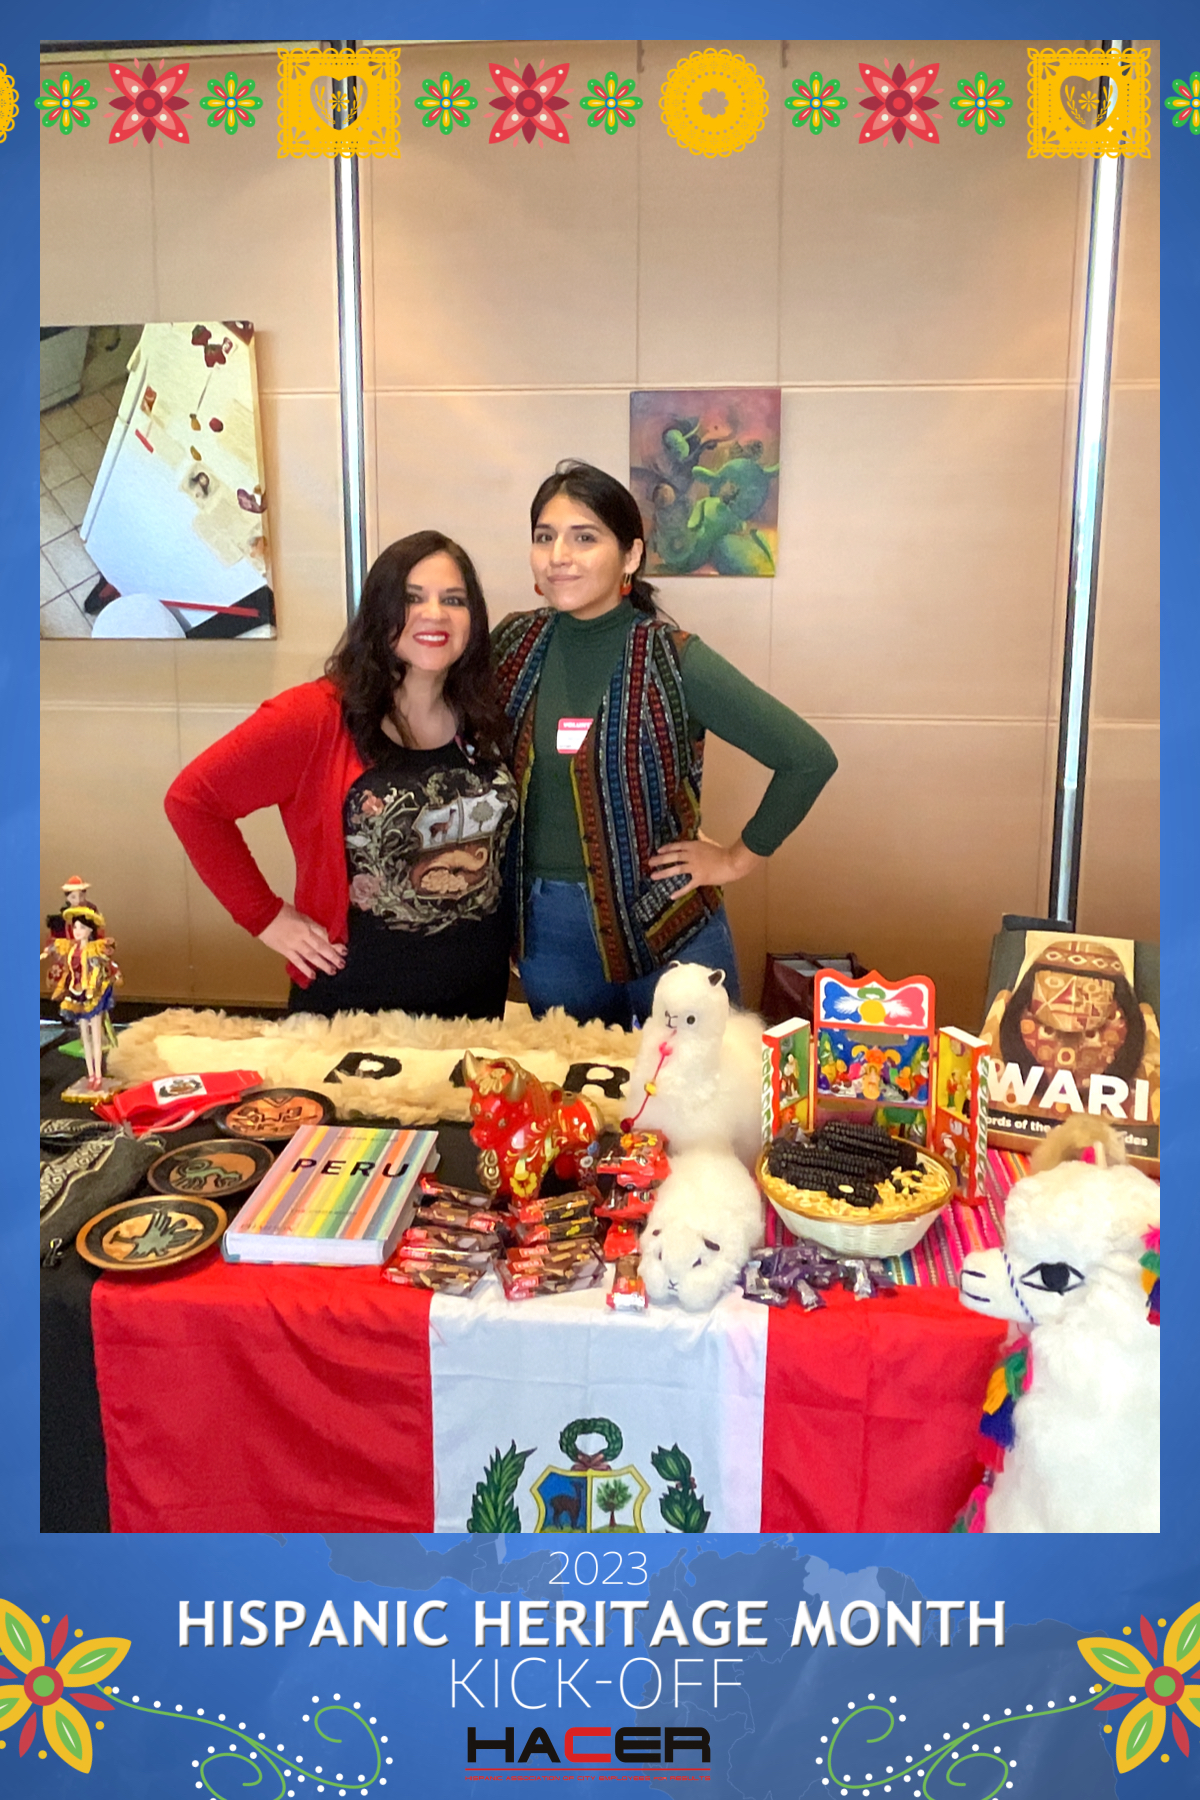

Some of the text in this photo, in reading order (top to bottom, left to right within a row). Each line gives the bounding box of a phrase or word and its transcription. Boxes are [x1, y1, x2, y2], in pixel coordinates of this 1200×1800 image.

[987, 1062, 1149, 1121] WARI
[984, 1116, 1012, 1128] ords
[1014, 1119, 1028, 1130] of
[1124, 1133, 1148, 1147] des
[291, 1158, 411, 1178] PERU
